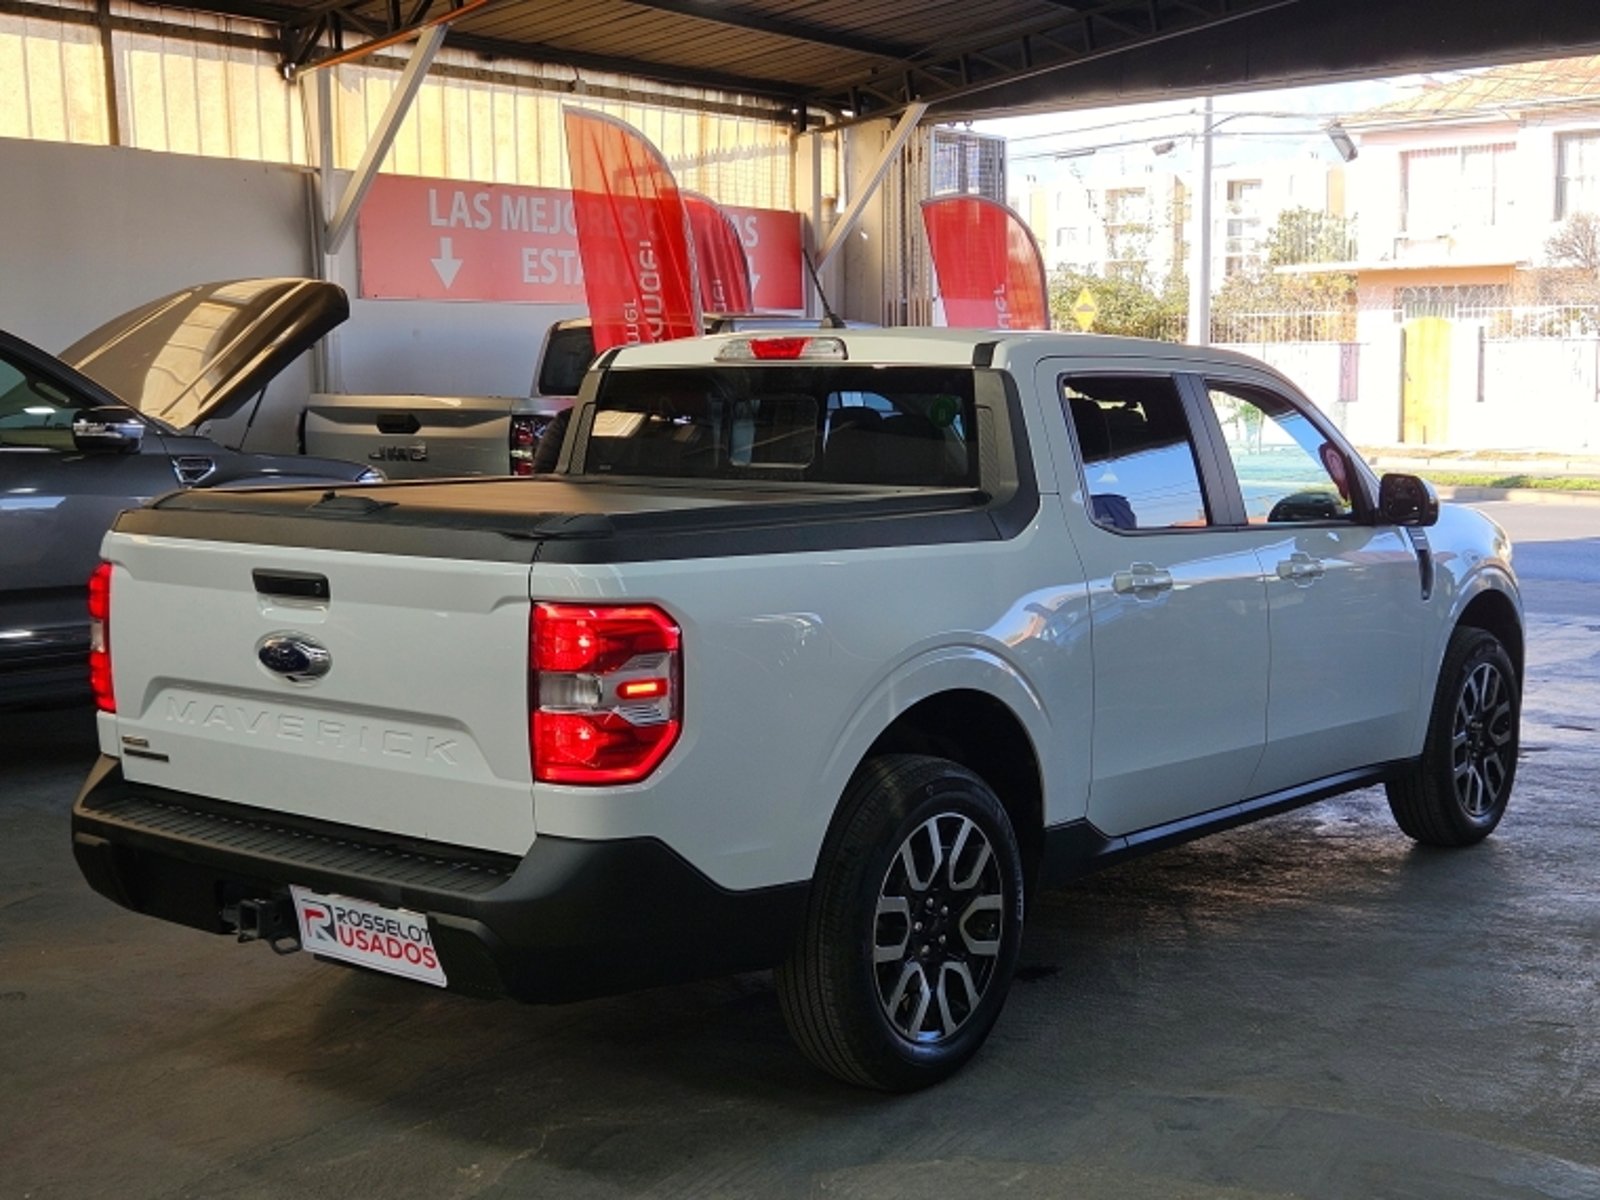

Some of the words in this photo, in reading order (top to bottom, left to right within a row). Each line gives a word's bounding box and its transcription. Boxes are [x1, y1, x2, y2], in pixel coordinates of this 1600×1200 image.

[428, 188, 493, 231] LAS
[165, 696, 459, 766] MAVERICK
[335, 906, 431, 945] ROSSELOT
[338, 925, 437, 969] USADOS
